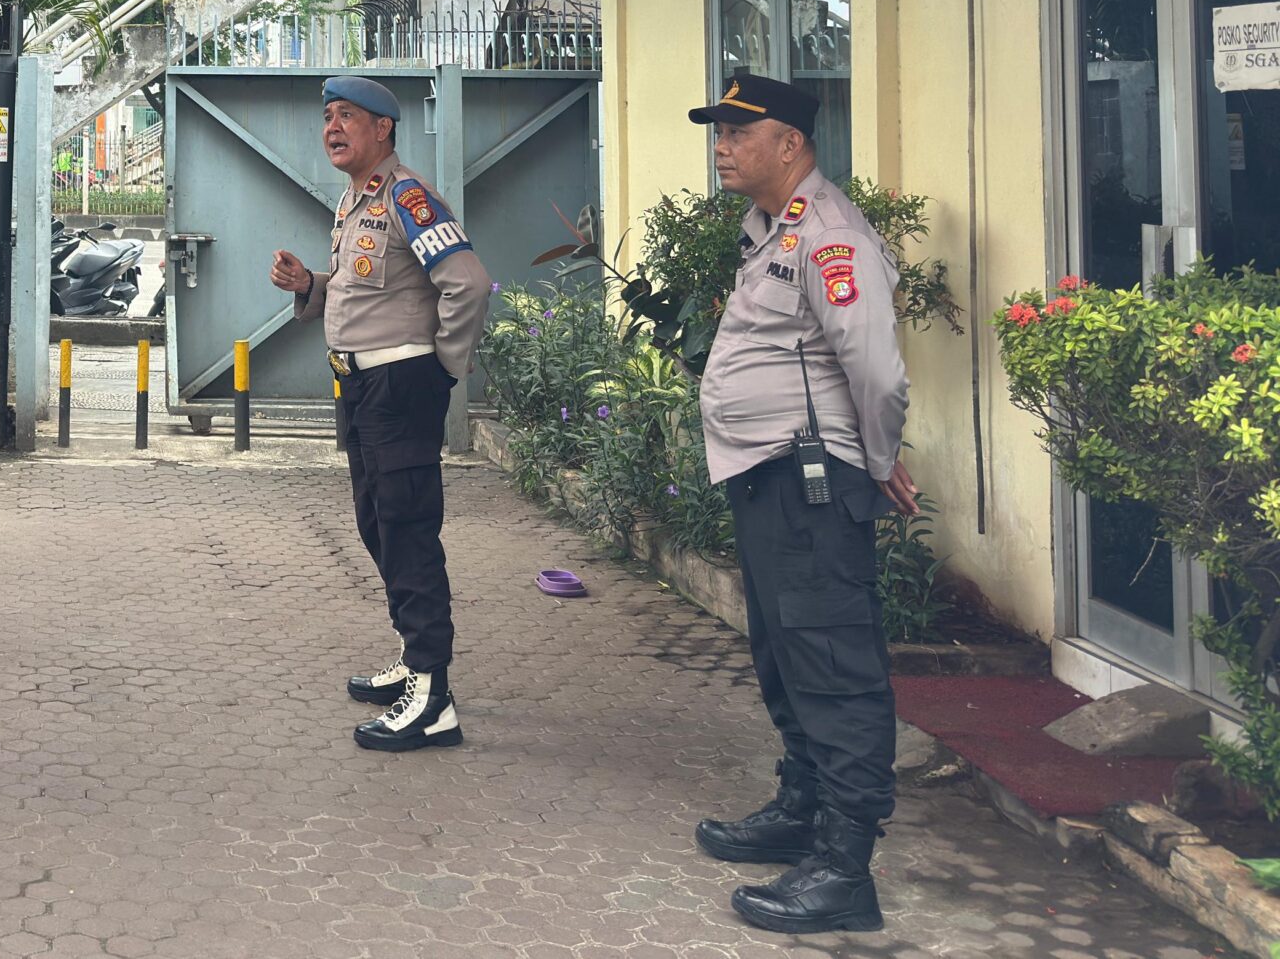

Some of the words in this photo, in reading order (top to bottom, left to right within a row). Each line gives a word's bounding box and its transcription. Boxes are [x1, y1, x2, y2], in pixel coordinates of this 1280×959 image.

[1217, 25, 1242, 46] POSKO
[1242, 21, 1280, 44] SECURITY
[358, 219, 388, 231] POLRI
[816, 246, 850, 259] POLSEK
[765, 261, 795, 283] POLRI
